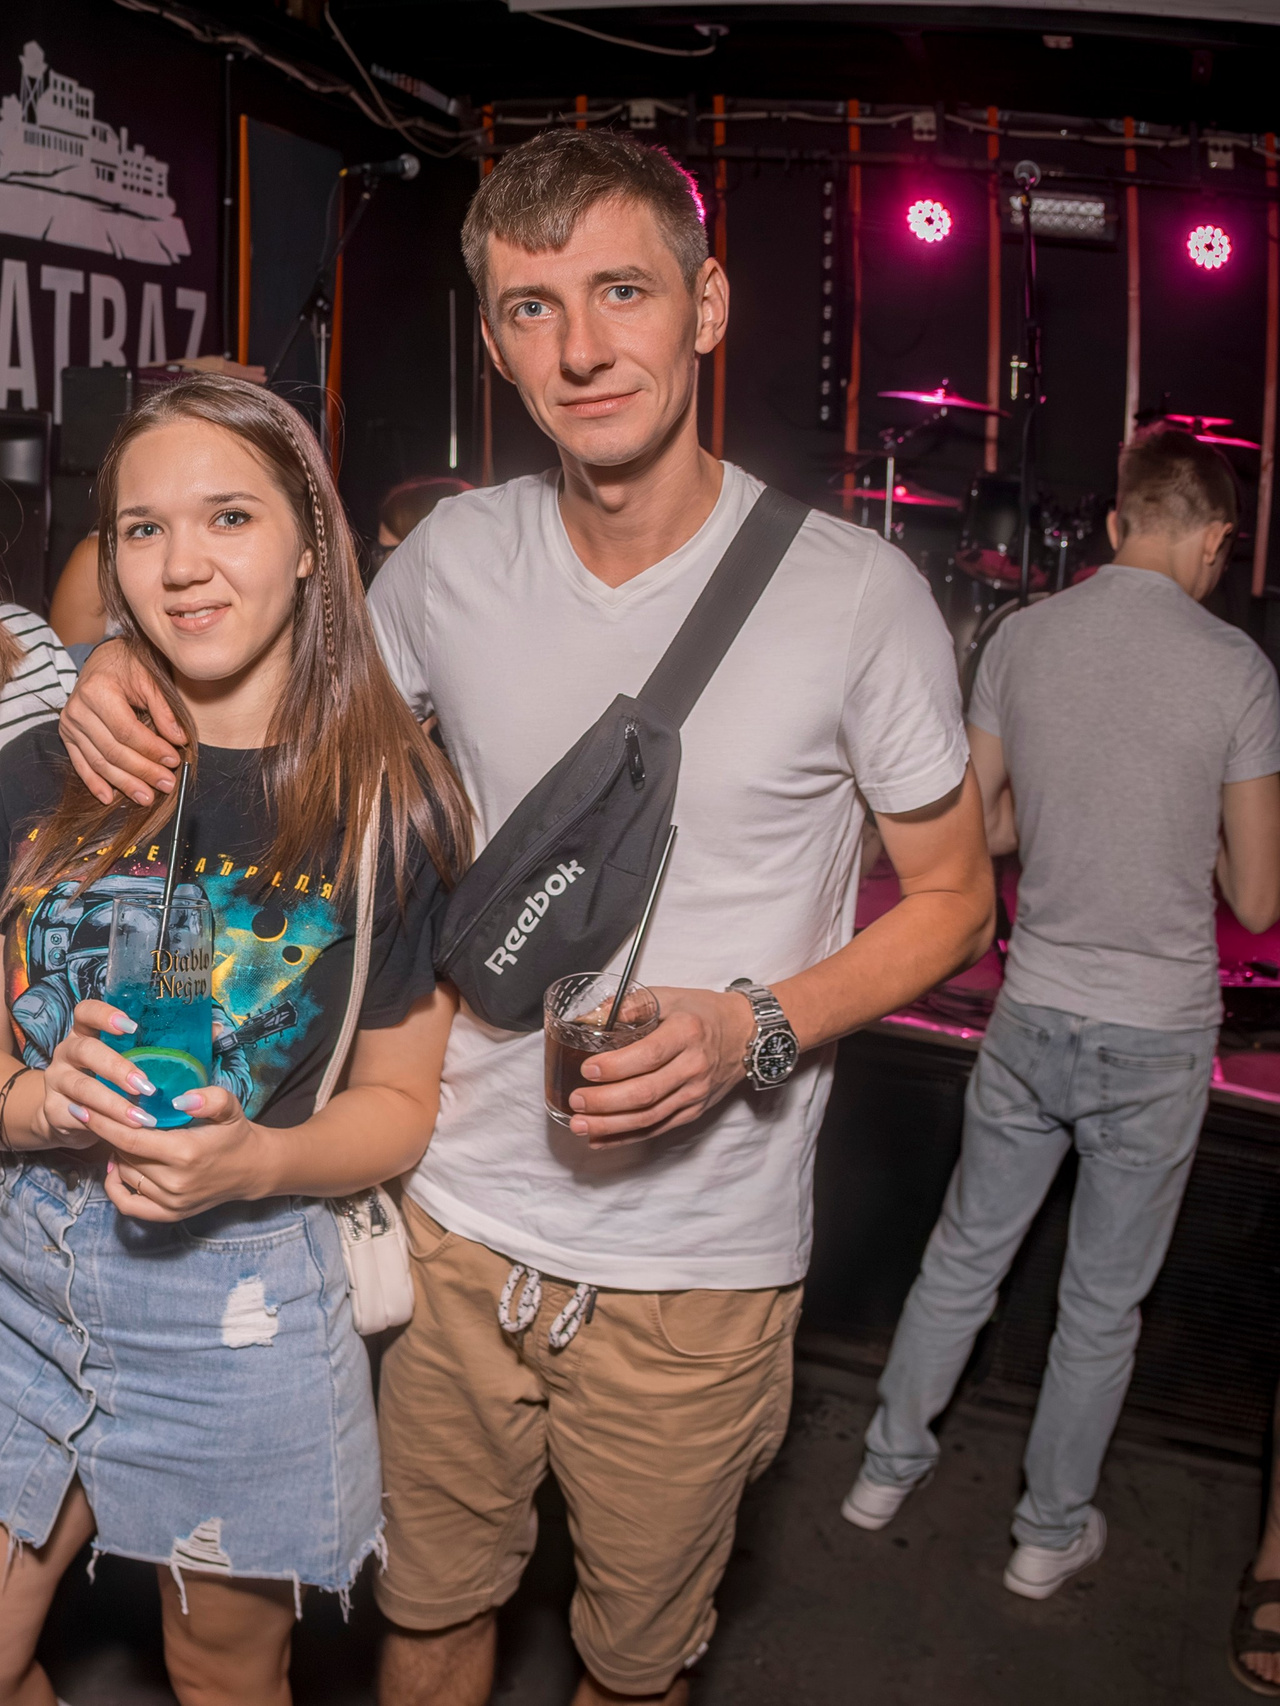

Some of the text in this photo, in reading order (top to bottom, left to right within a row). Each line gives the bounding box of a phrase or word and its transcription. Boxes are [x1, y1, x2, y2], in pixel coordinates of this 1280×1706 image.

[194, 857, 336, 900] АПРЕЛЯ
[484, 859, 586, 976] Reebok
[150, 947, 210, 974] Diablo
[156, 974, 207, 1006] Negro
